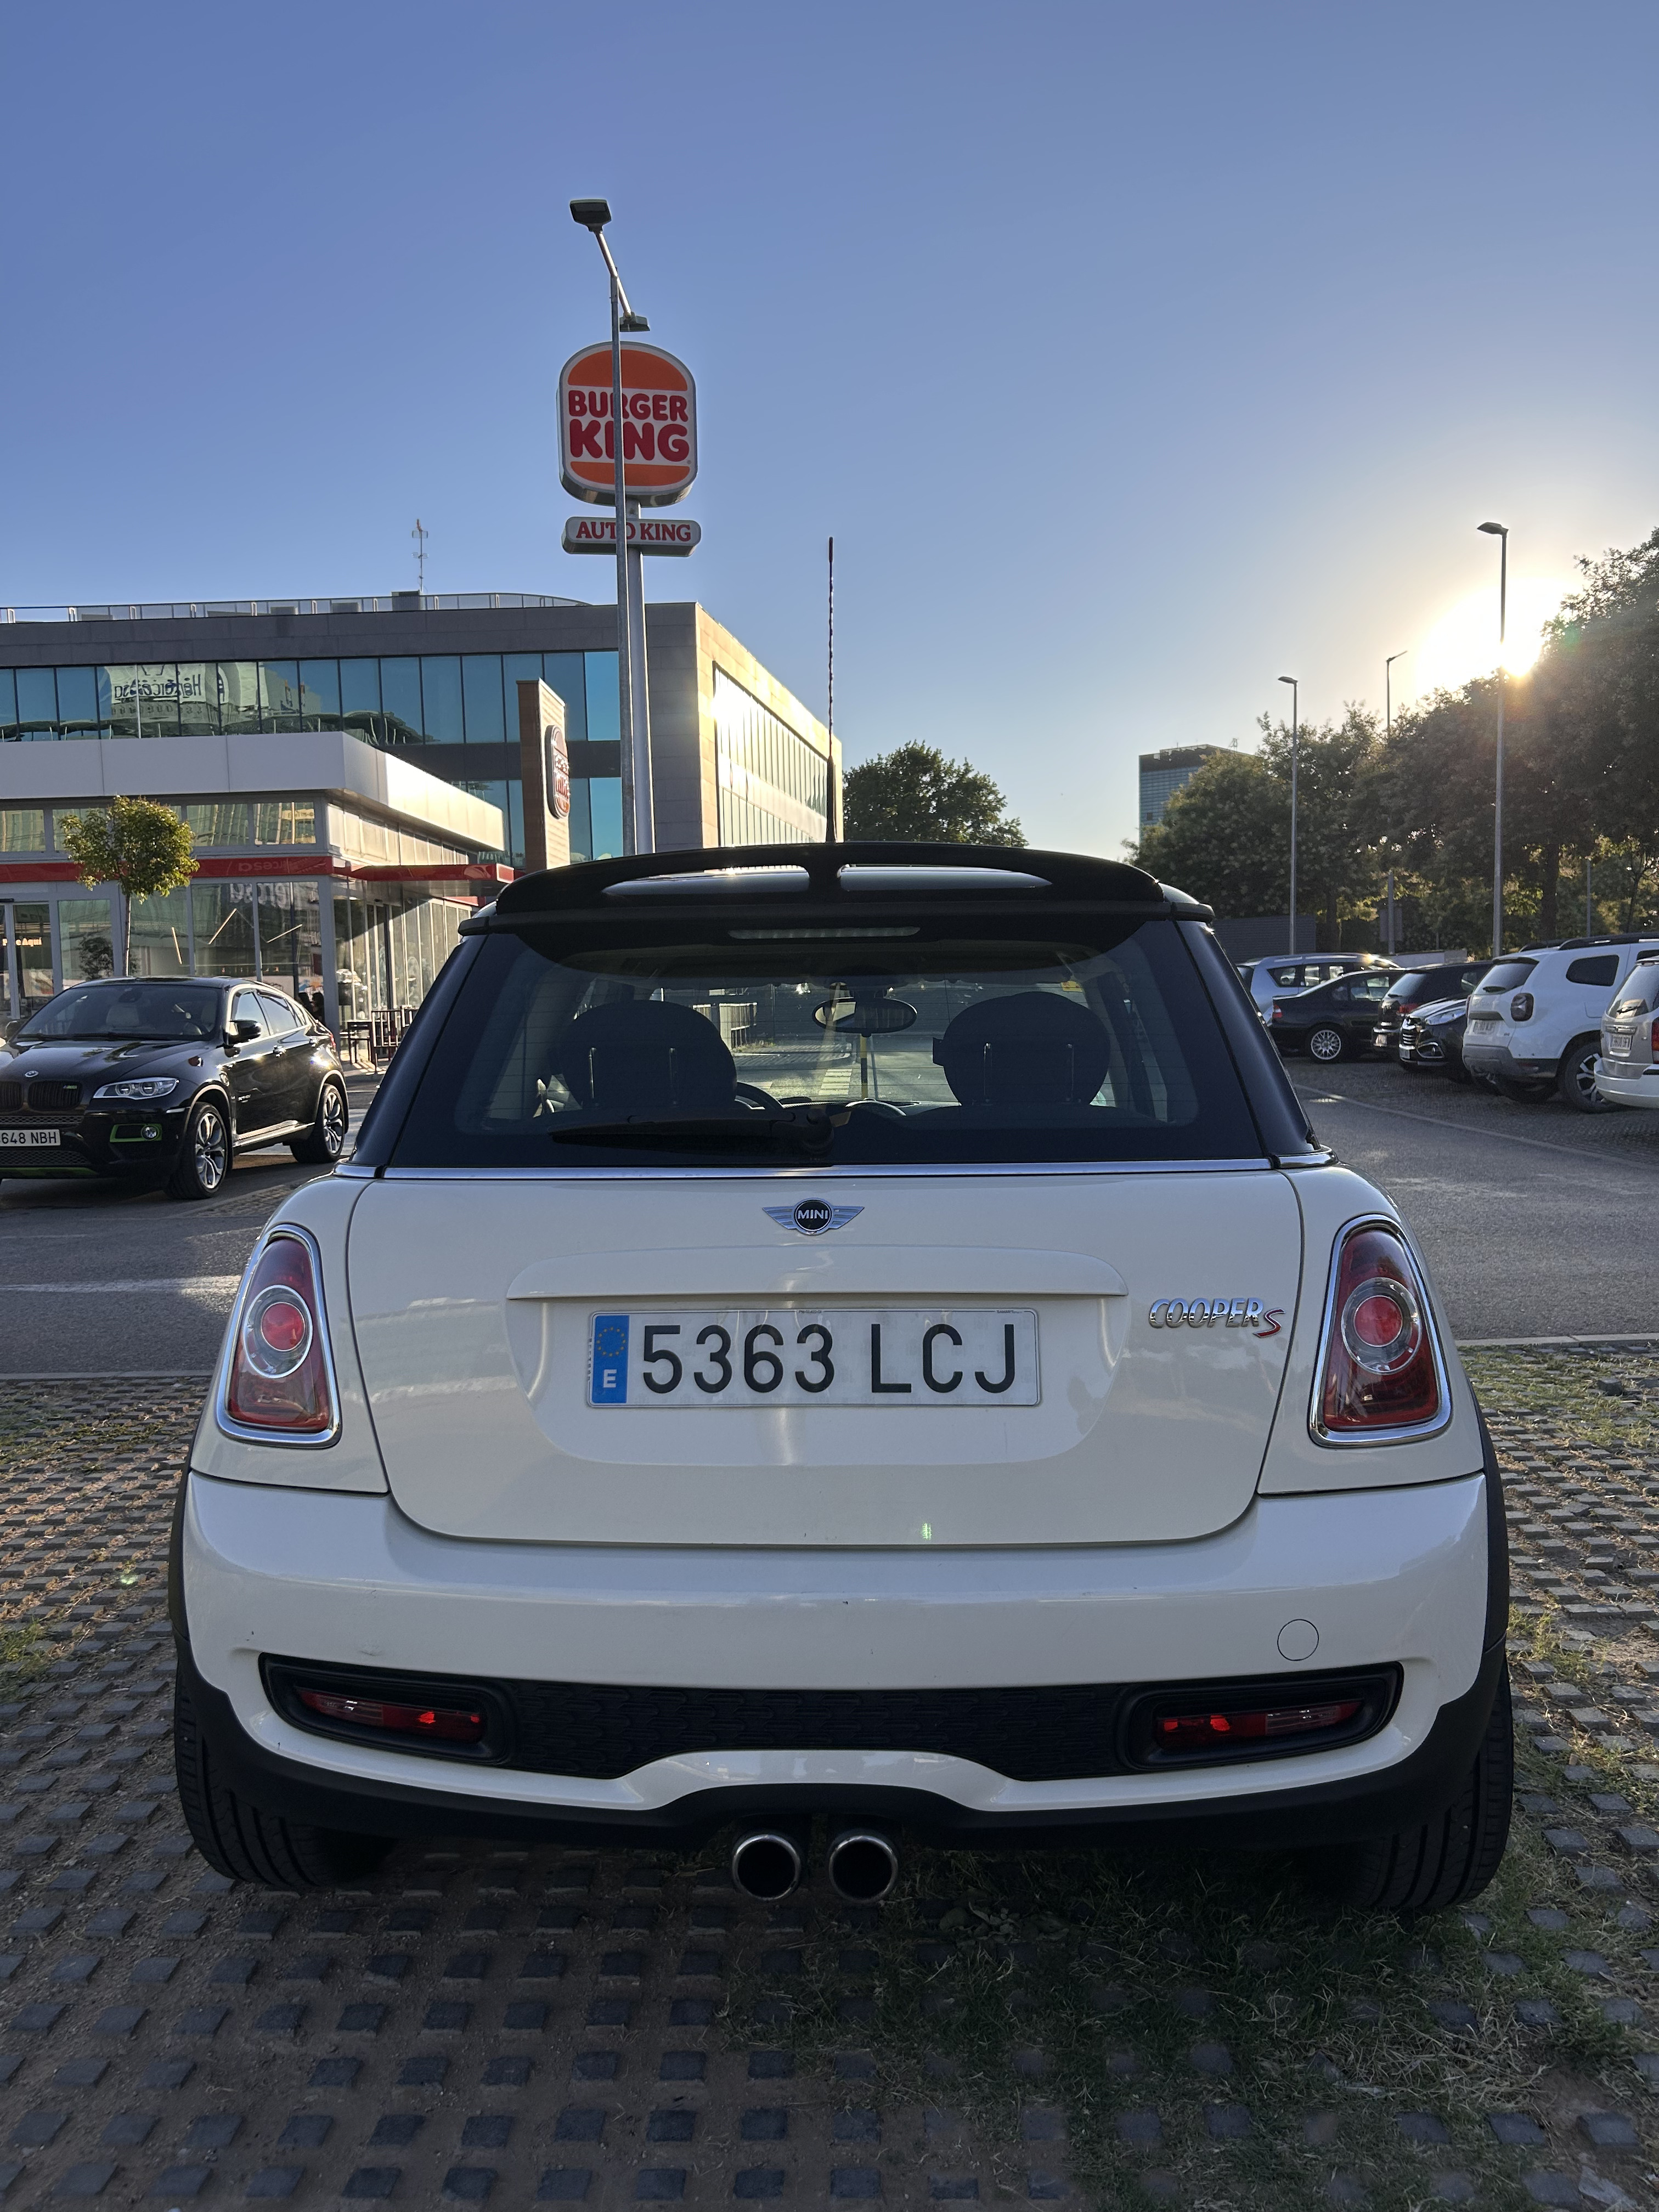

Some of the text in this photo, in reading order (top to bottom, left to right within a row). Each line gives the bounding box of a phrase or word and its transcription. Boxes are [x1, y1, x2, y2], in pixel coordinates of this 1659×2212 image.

[568, 390, 689, 422] BURGER
[569, 419, 690, 462] KING
[576, 521, 691, 541] AUTO KING
[2, 938, 21, 946] Pe
[0, 1132, 57, 1144] 648 NBH
[798, 1210, 828, 1220] MINI
[1149, 1297, 1286, 1338] COOPER S
[643, 1324, 834, 1394] 5363
[871, 1324, 1015, 1394] LCJ
[603, 1369, 617, 1387] E
